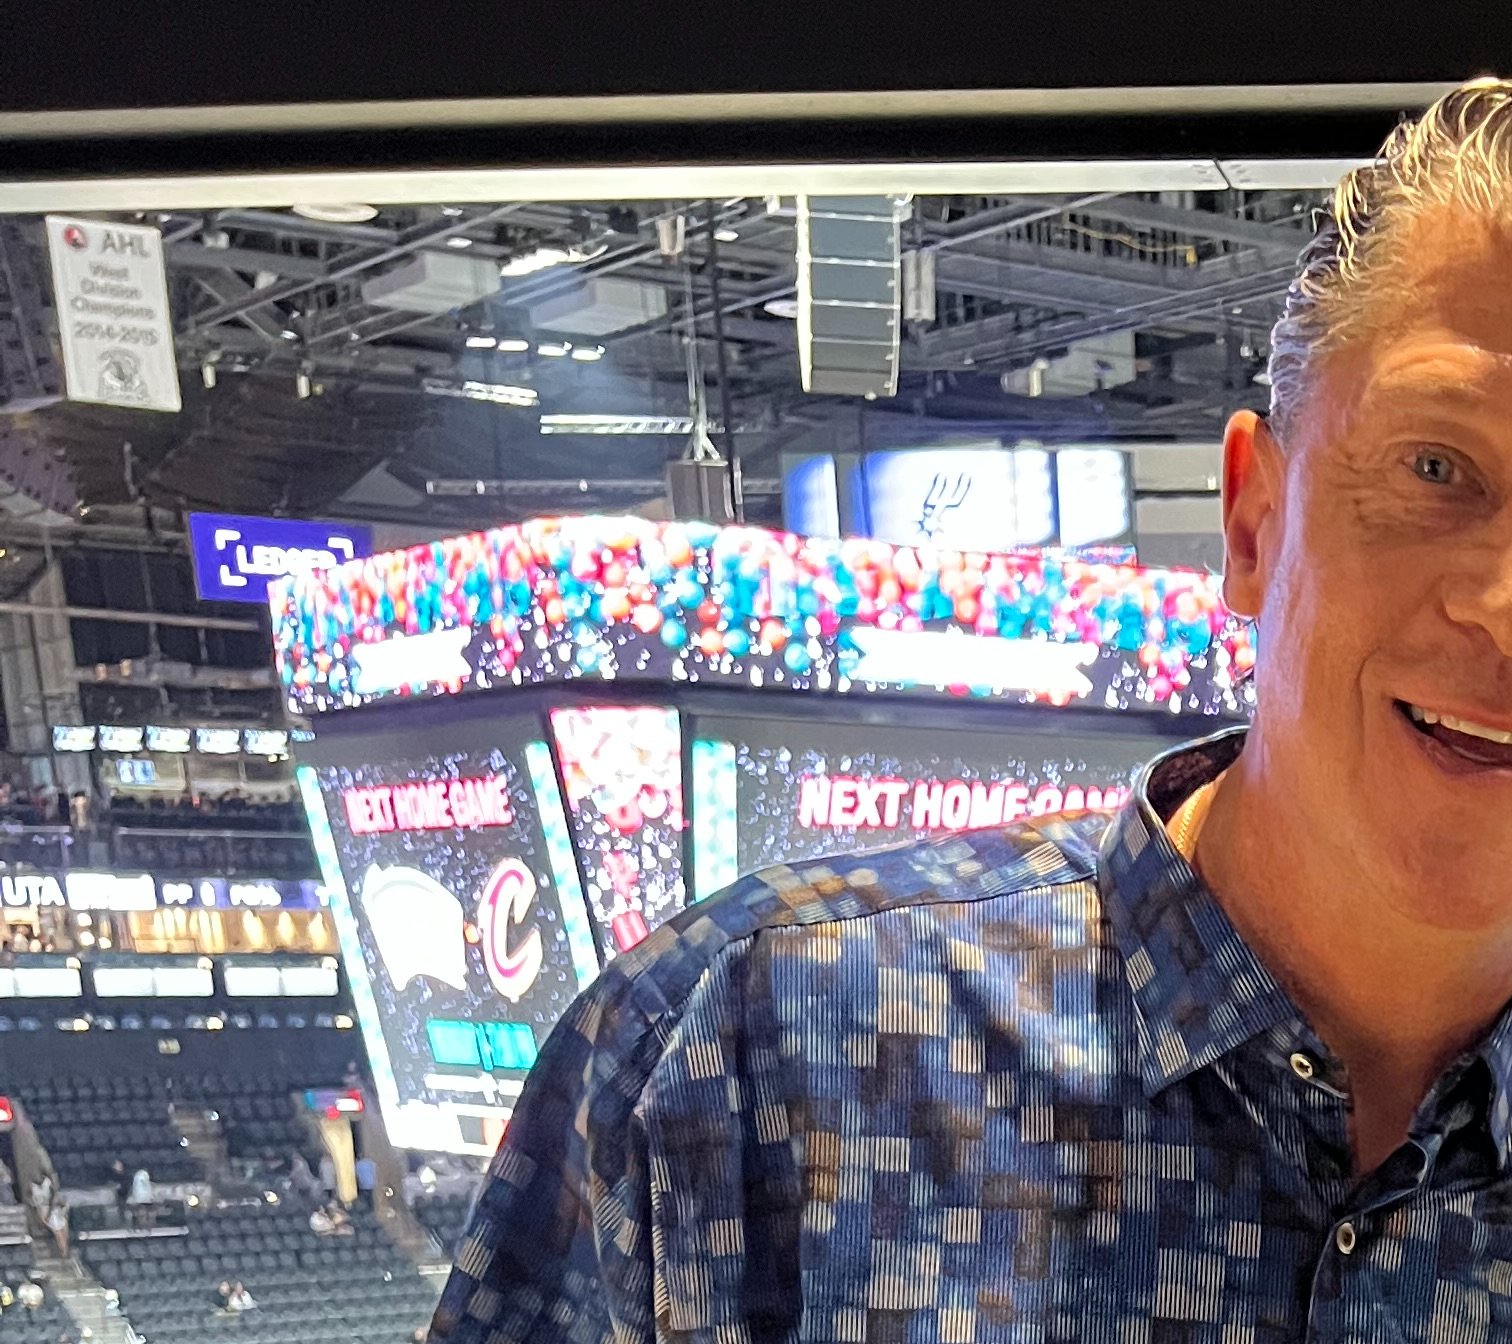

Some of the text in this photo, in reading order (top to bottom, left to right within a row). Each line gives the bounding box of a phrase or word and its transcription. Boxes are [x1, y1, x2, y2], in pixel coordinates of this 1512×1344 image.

[101, 231, 151, 259] AHL
[344, 772, 514, 837] NEXT HOME GAME
[800, 775, 908, 829] NEXT
[911, 778, 1028, 830] HOME
[2, 875, 66, 907] UTA
